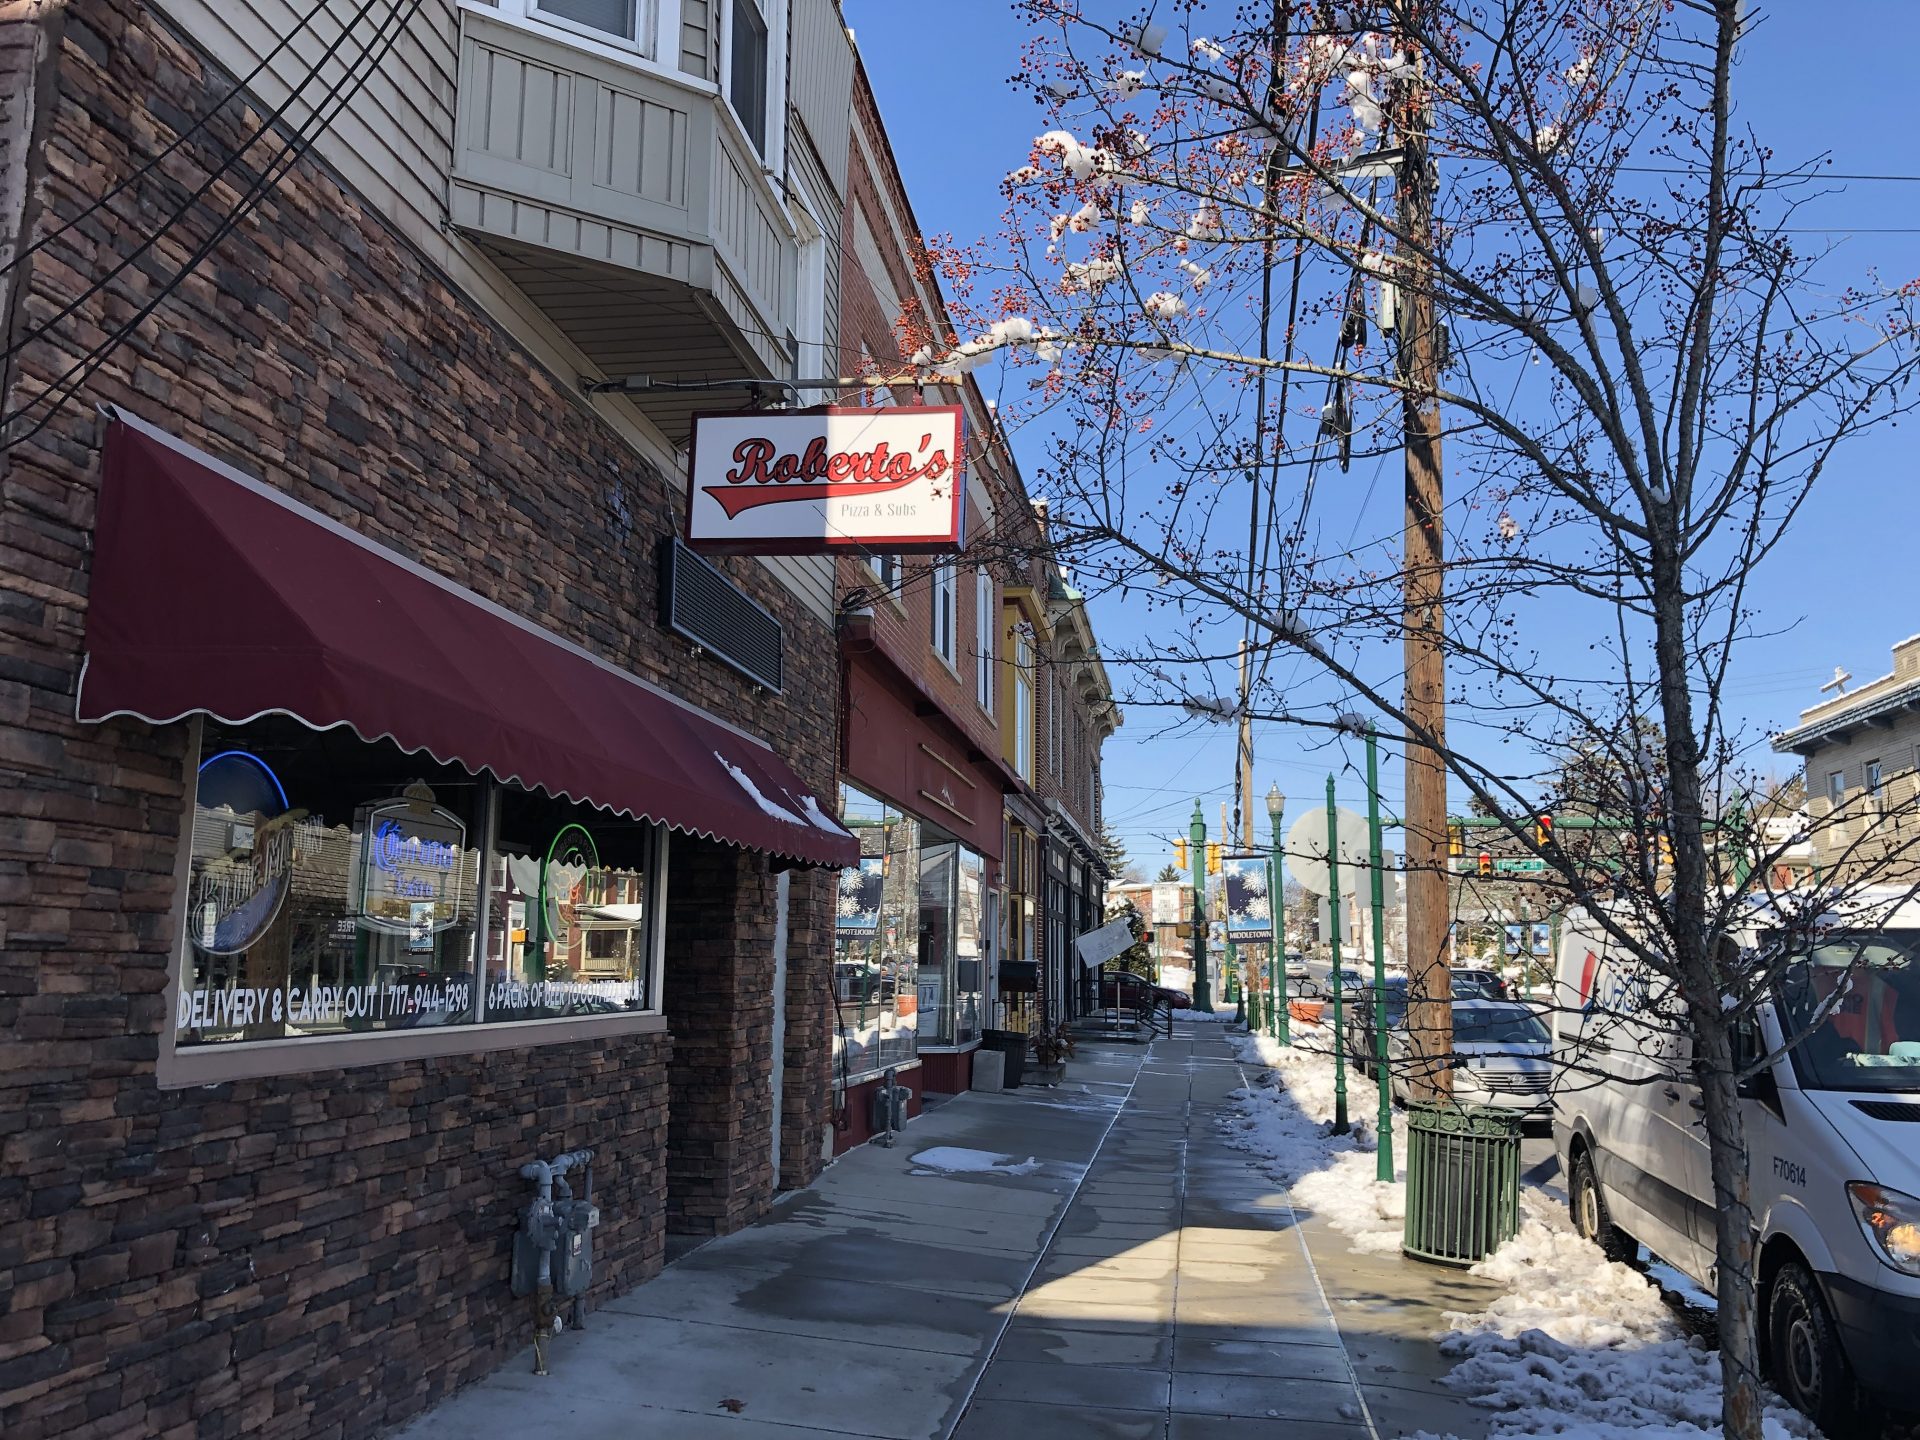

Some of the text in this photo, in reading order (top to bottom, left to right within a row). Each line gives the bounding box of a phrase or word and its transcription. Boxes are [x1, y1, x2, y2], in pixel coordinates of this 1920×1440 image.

[726, 433, 948, 484] Roberto's
[841, 503, 917, 517] Pizza & Subs
[375, 820, 454, 872] Corona
[1229, 931, 1272, 939] MIDDLETOWN
[177, 988, 269, 1029] DELIVERY
[271, 988, 283, 1023] &
[287, 986, 343, 1021] CARRY
[345, 985, 377, 1018] OUT
[488, 983, 495, 1010] 6
[496, 983, 529, 1010] PACKS
[531, 982, 544, 1008] OF
[544, 980, 565, 1006] BEER
[567, 981, 578, 1005] TO
[581, 980, 593, 1004] GO
[1773, 1156, 1806, 1188] F70614
